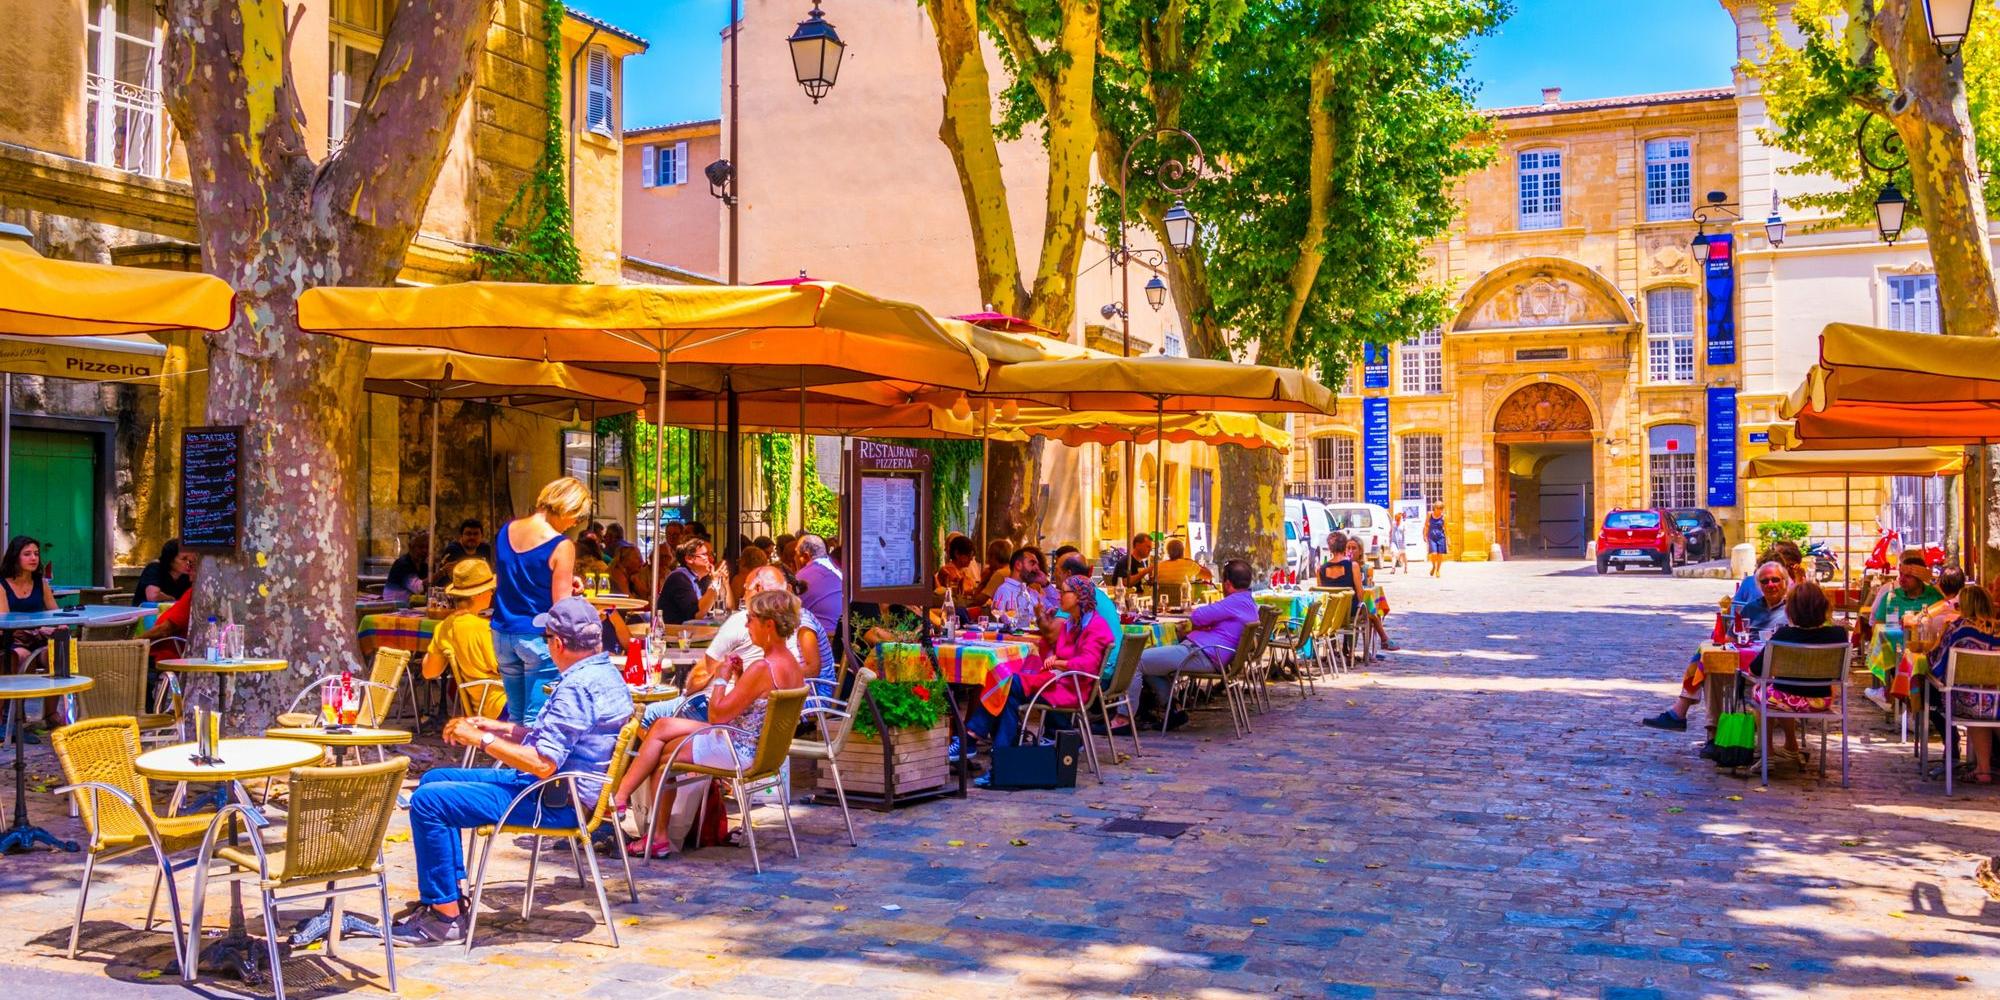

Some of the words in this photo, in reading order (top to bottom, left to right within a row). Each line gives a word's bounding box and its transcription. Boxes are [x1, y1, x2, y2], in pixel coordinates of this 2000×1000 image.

[66, 357, 151, 377] Pizzeria
[860, 440, 918, 459] RESTAURANT
[875, 458, 913, 470] PIZZERIA
